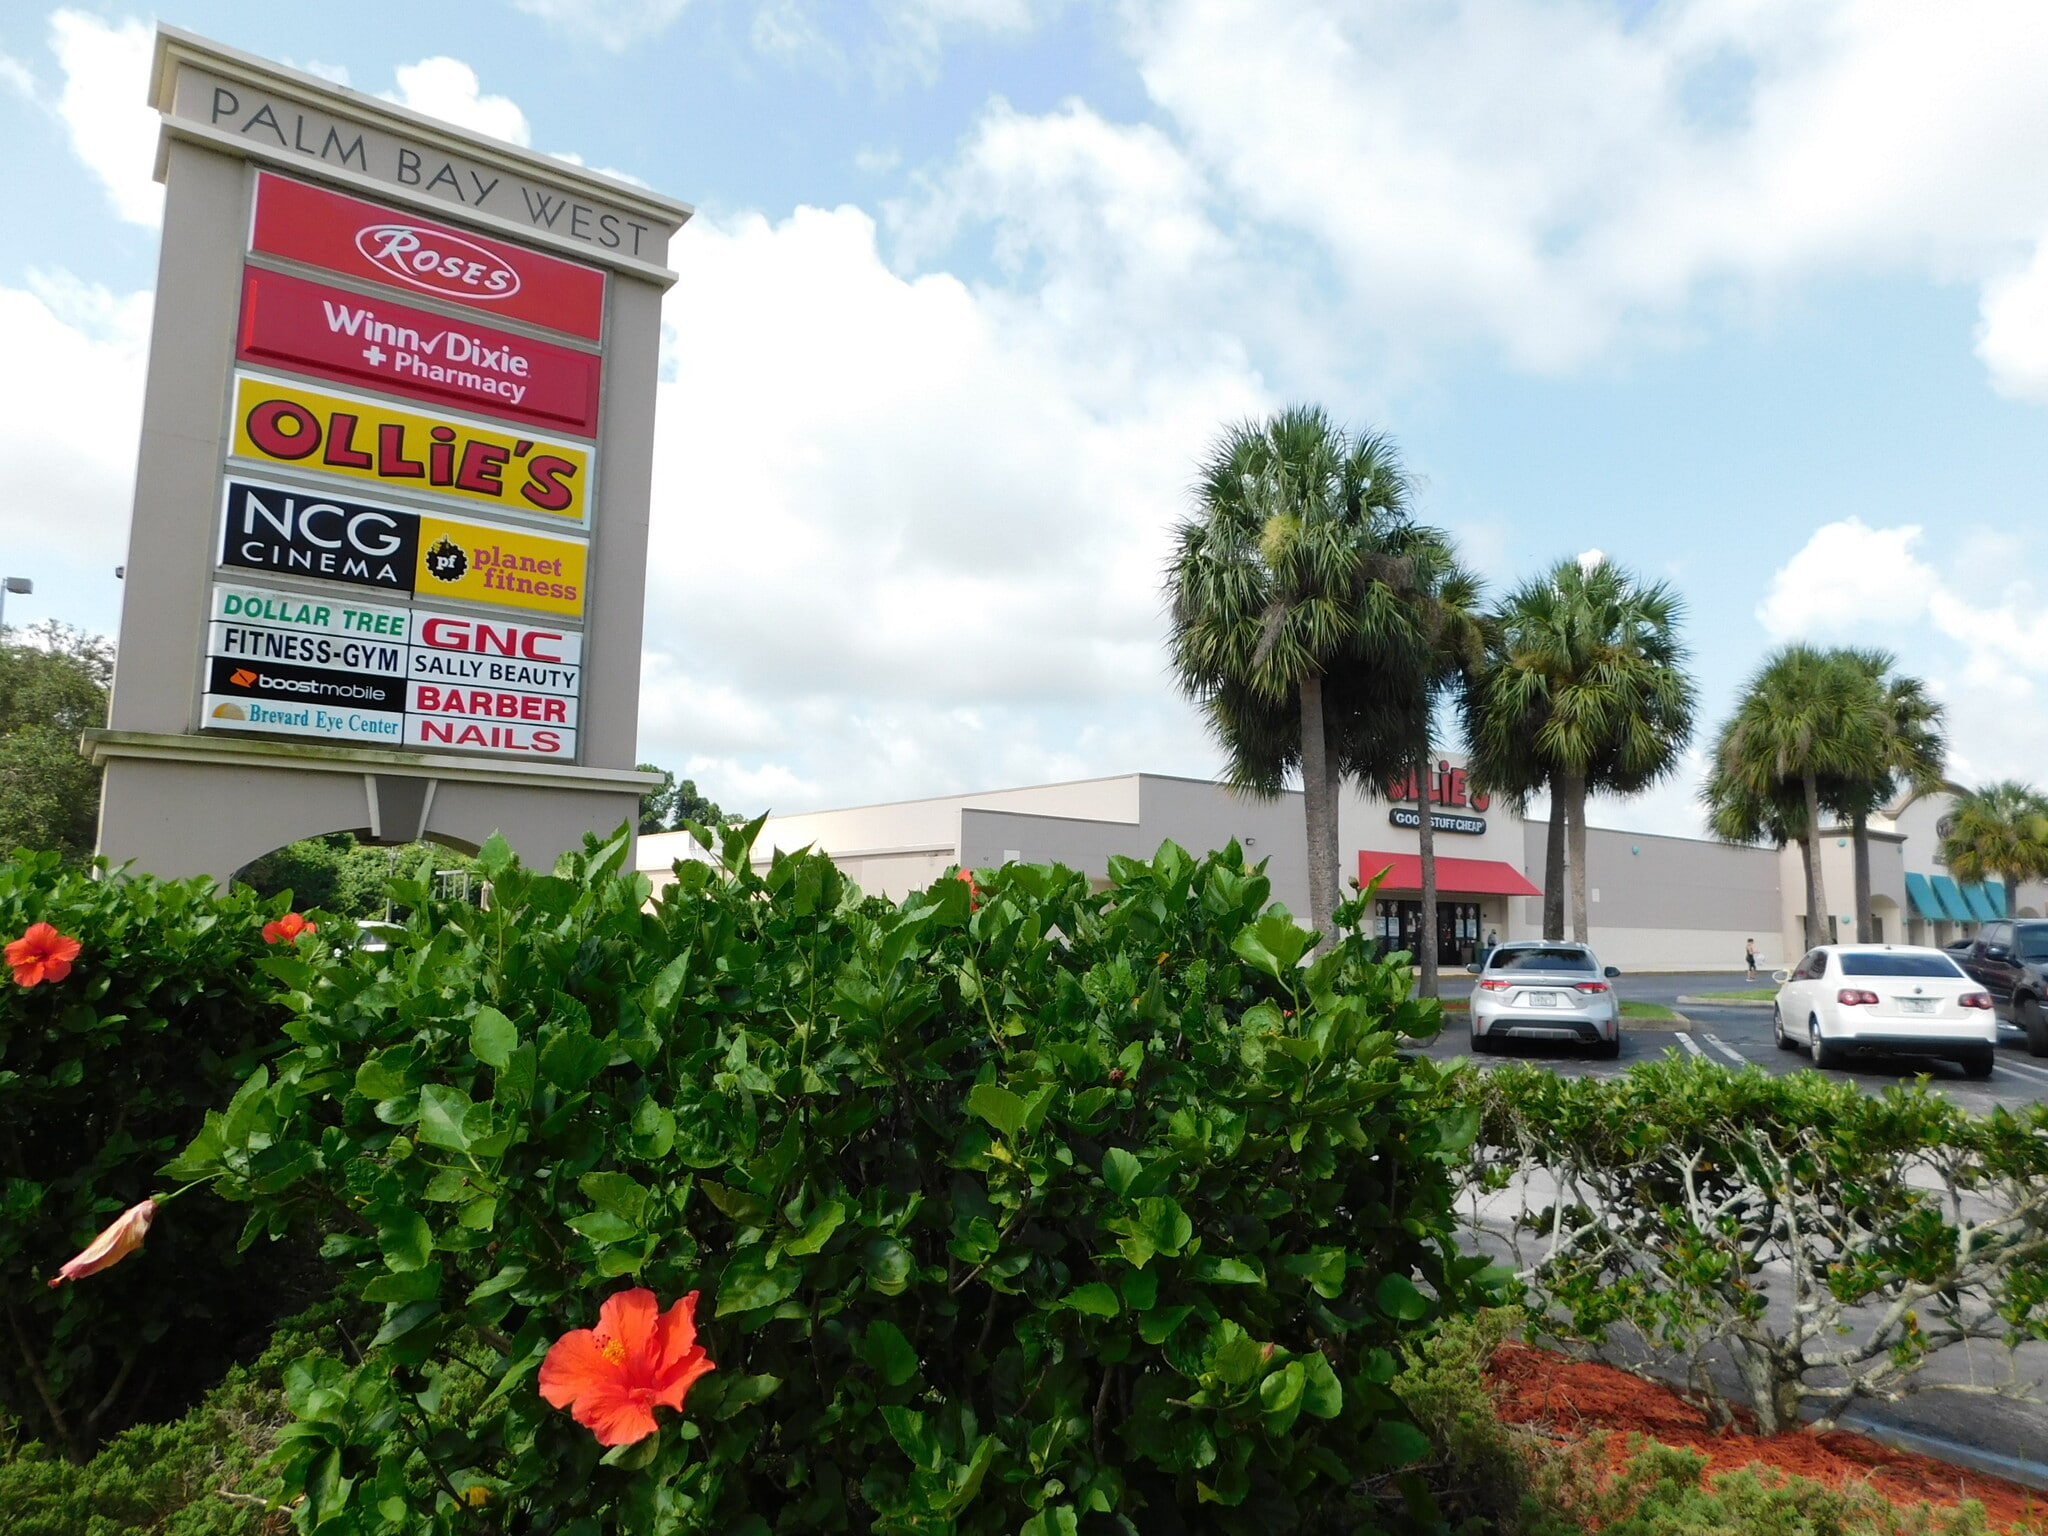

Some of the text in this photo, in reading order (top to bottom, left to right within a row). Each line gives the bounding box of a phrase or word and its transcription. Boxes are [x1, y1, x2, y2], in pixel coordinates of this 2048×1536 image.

[212, 87, 648, 256] PALM BAY WEST
[373, 228, 511, 291] ROSES
[322, 300, 529, 376] Winn Dixie
[395, 352, 527, 405] Pharmacy
[246, 399, 578, 511] OLLiE'S
[243, 491, 401, 557] NCG
[241, 542, 398, 583] CINEMA
[436, 555, 457, 570] pf
[472, 546, 563, 577] planet
[483, 568, 578, 601] fitness
[224, 595, 405, 636] DOLLAR TREE
[224, 628, 399, 672] FITNESS-GYM
[421, 617, 563, 663] GNC
[414, 655, 576, 689] SALLY BEAUTY
[249, 704, 399, 735] Brevard Eye Center
[417, 686, 566, 723] BARBER
[420, 720, 561, 753] NAILS
